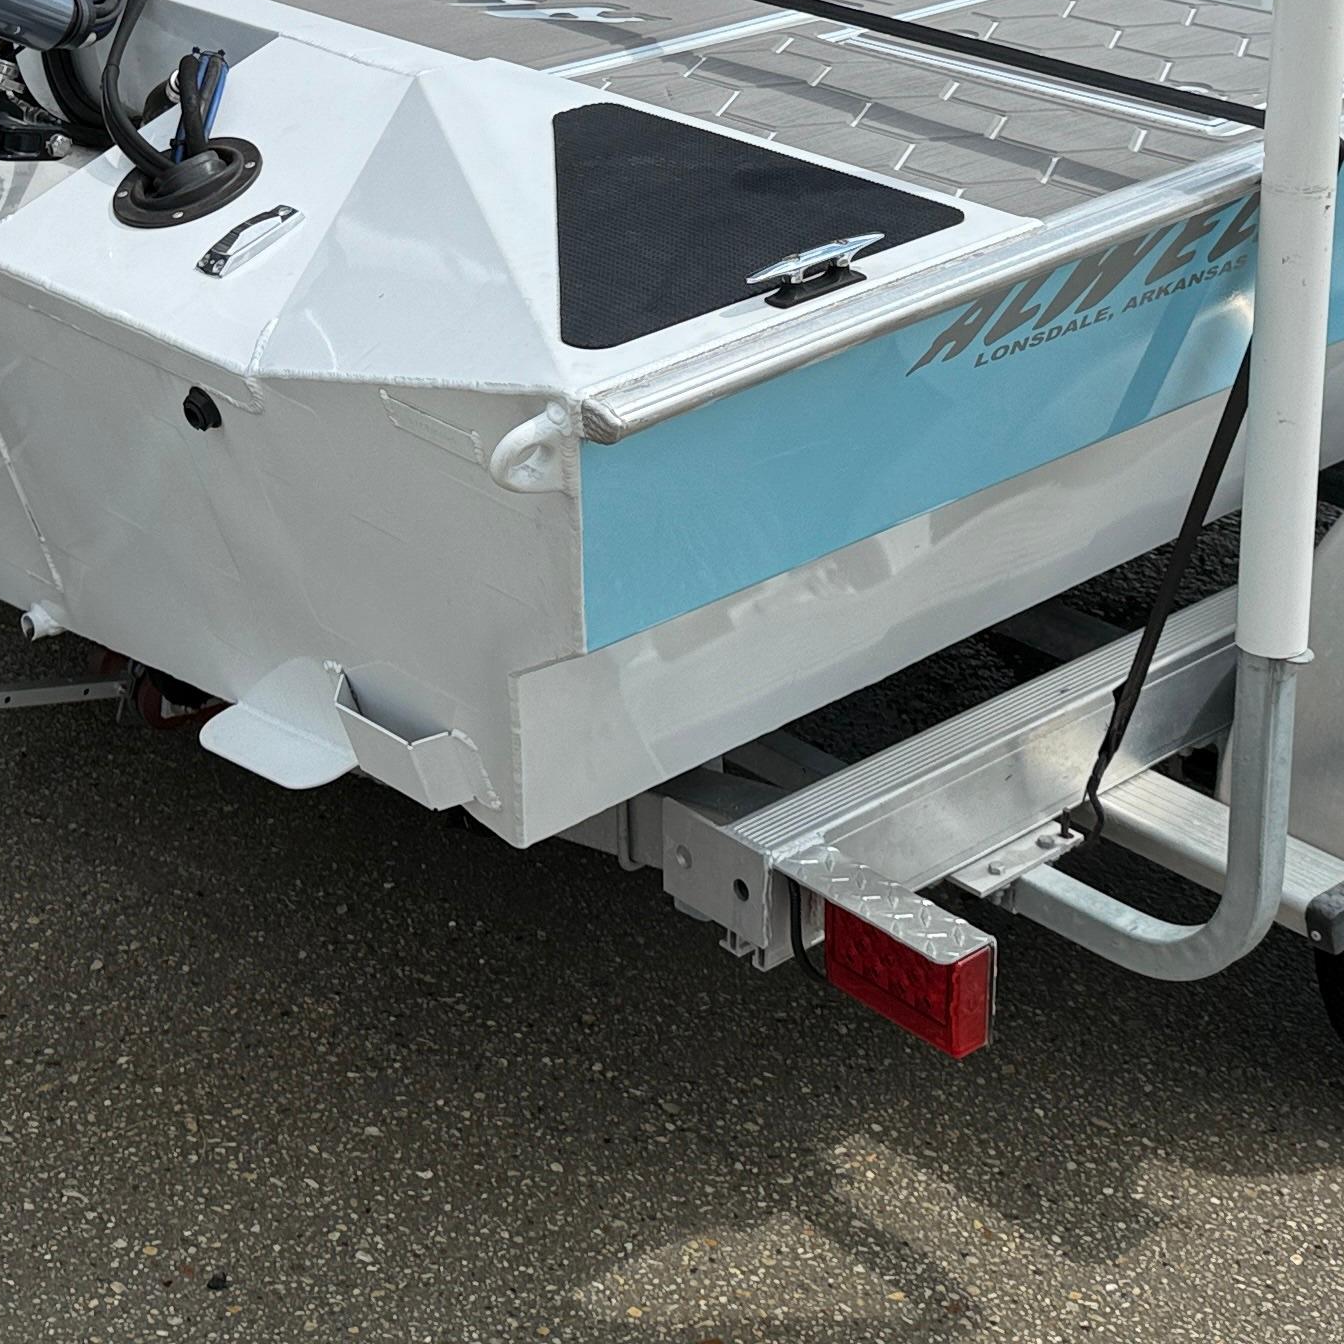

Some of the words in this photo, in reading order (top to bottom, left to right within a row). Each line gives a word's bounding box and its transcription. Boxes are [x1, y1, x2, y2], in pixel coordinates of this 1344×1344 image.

[905, 189, 1259, 377] ALWEL
[972, 306, 1115, 369] LONSDALE,
[1121, 254, 1249, 313] ARKANSAS
